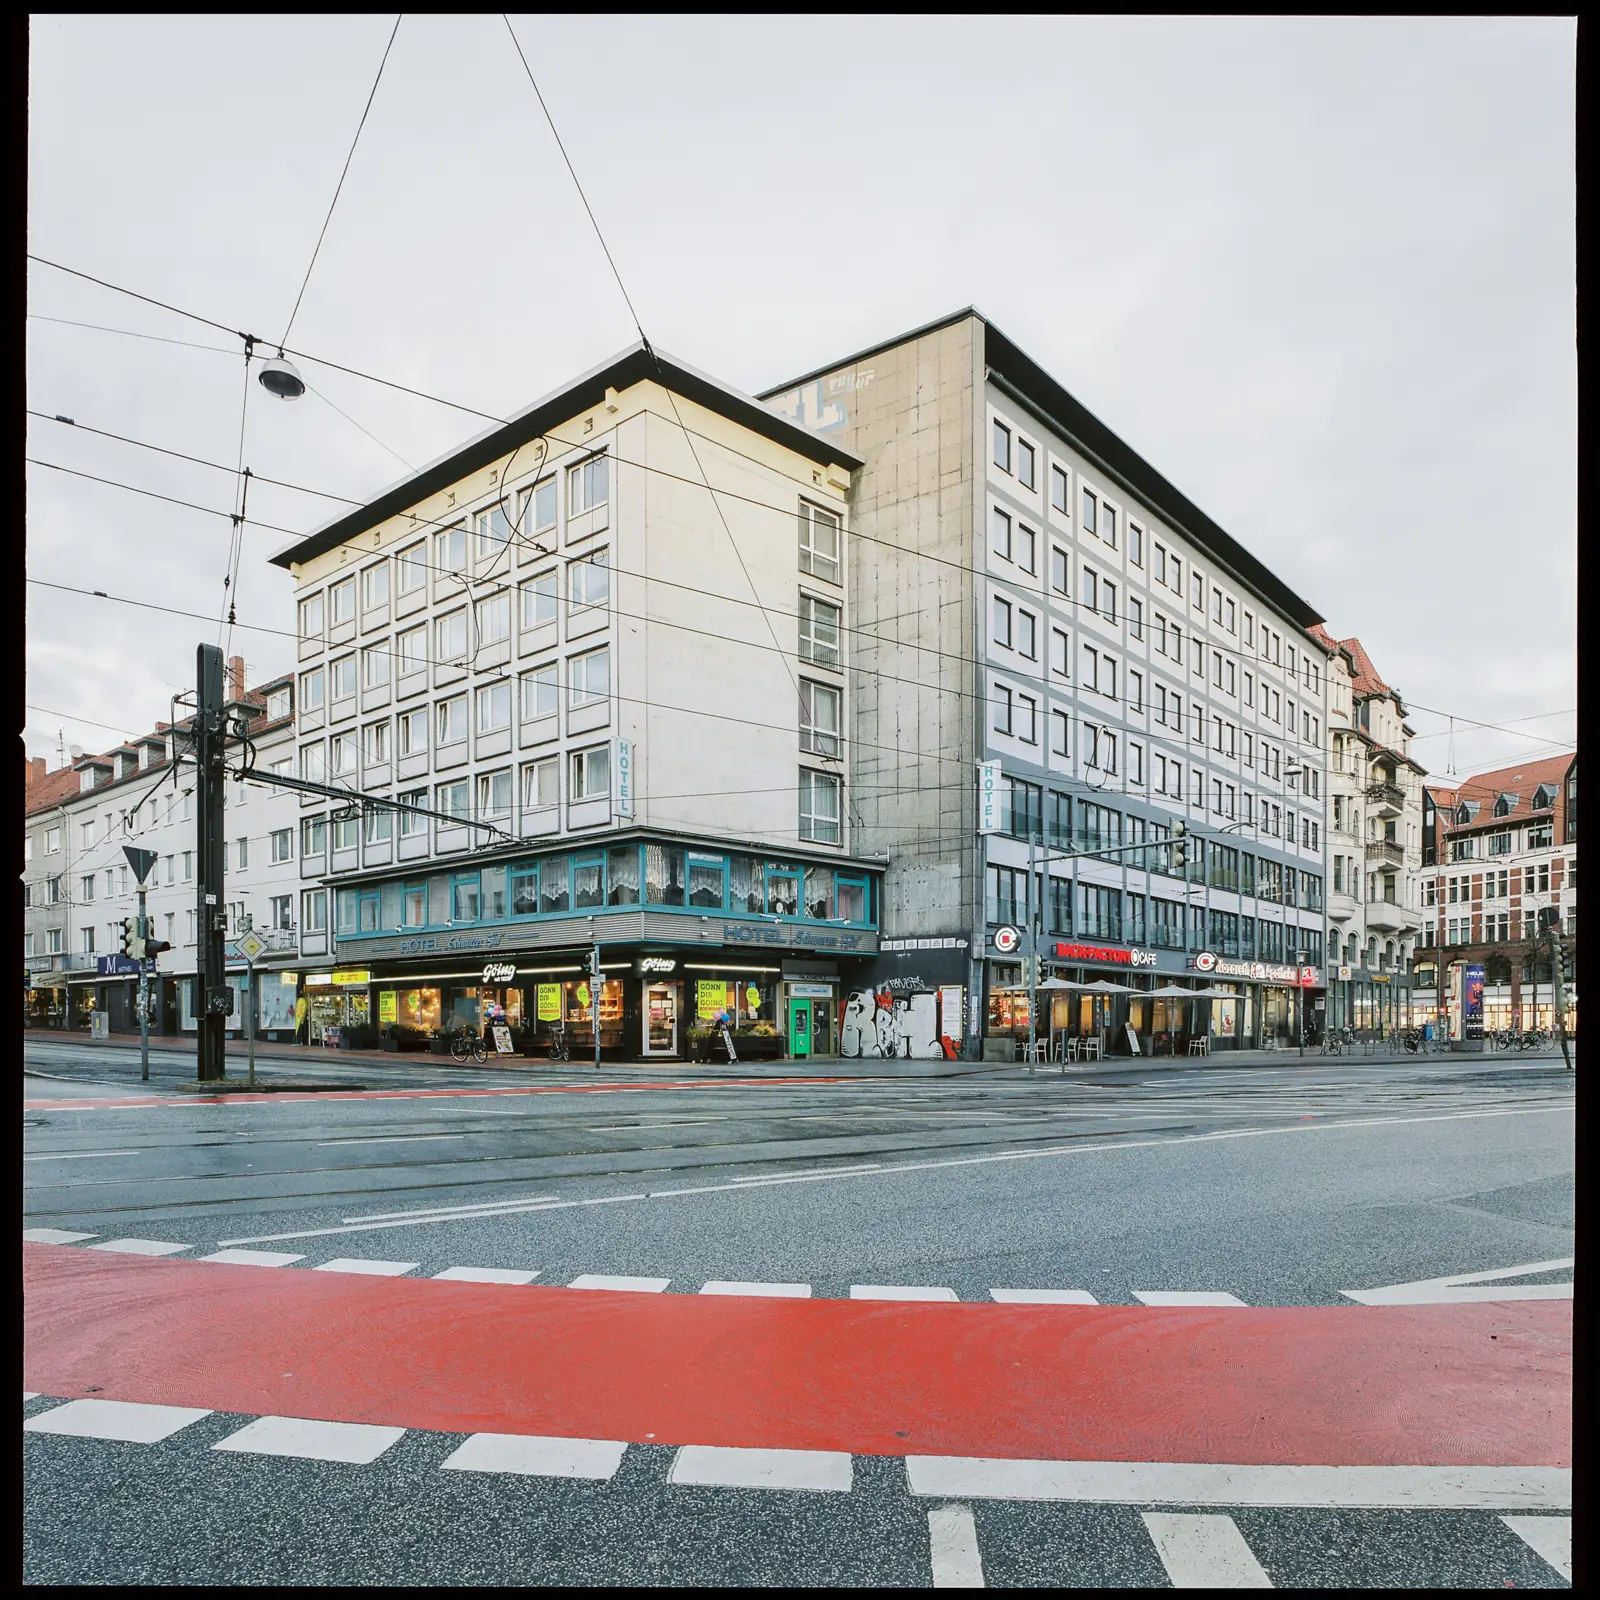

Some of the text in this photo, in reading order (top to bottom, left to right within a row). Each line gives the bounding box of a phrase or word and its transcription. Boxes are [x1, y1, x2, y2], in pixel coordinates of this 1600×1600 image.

[619, 742, 629, 812] HOTEL
[984, 766, 994, 829] HOTEL
[724, 924, 787, 944] HOTEL
[399, 938, 441, 954] HOTEL
[1139, 952, 1157, 966] CAFE
[482, 962, 516, 983] Göing
